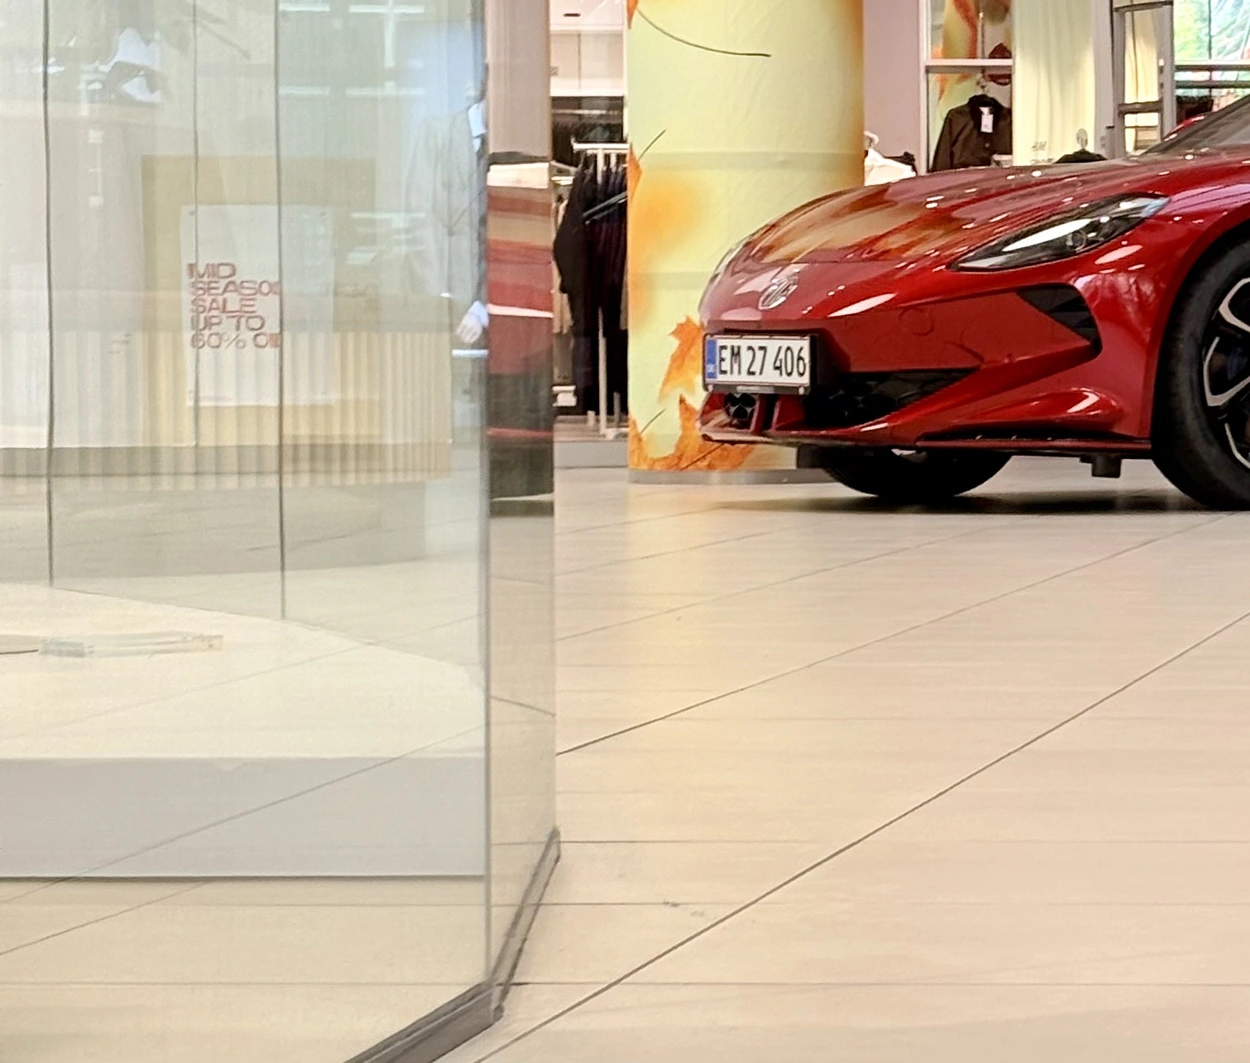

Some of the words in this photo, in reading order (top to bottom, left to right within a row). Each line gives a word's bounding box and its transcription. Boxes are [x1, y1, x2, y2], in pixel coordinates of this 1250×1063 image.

[187, 263, 236, 278] MID
[191, 297, 257, 314] SALE
[191, 315, 221, 331] UP
[226, 315, 265, 331] TO
[191, 332, 246, 350] 60%
[718, 345, 742, 375] EM
[746, 346, 768, 376] 27
[773, 346, 807, 377] 406
